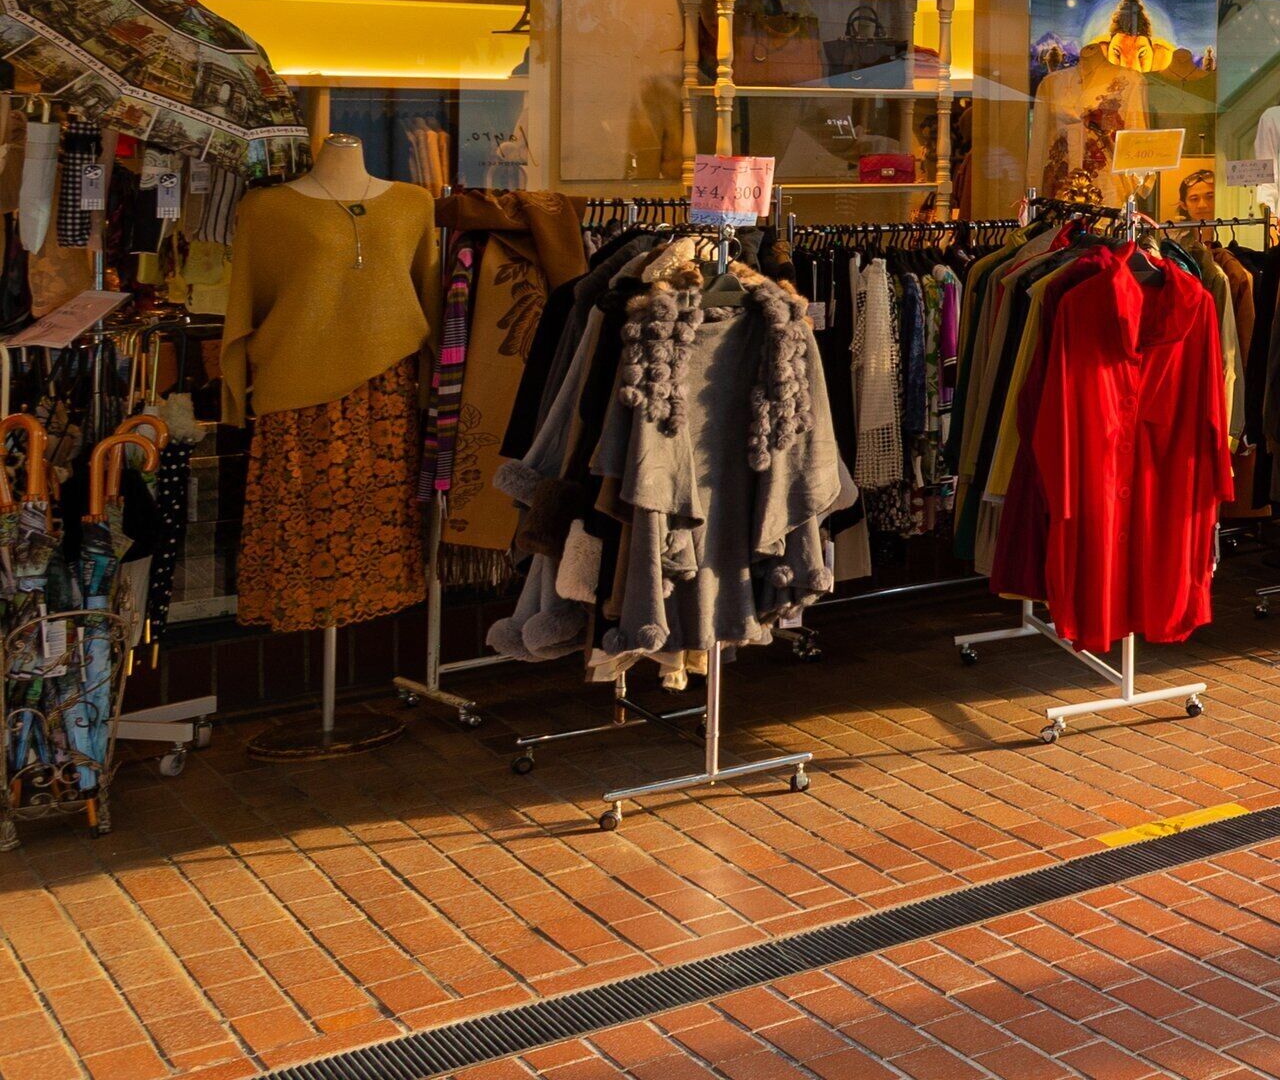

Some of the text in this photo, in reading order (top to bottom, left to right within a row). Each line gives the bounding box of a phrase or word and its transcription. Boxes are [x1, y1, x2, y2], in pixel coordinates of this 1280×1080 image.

[696, 162, 773, 176] ファーコート
